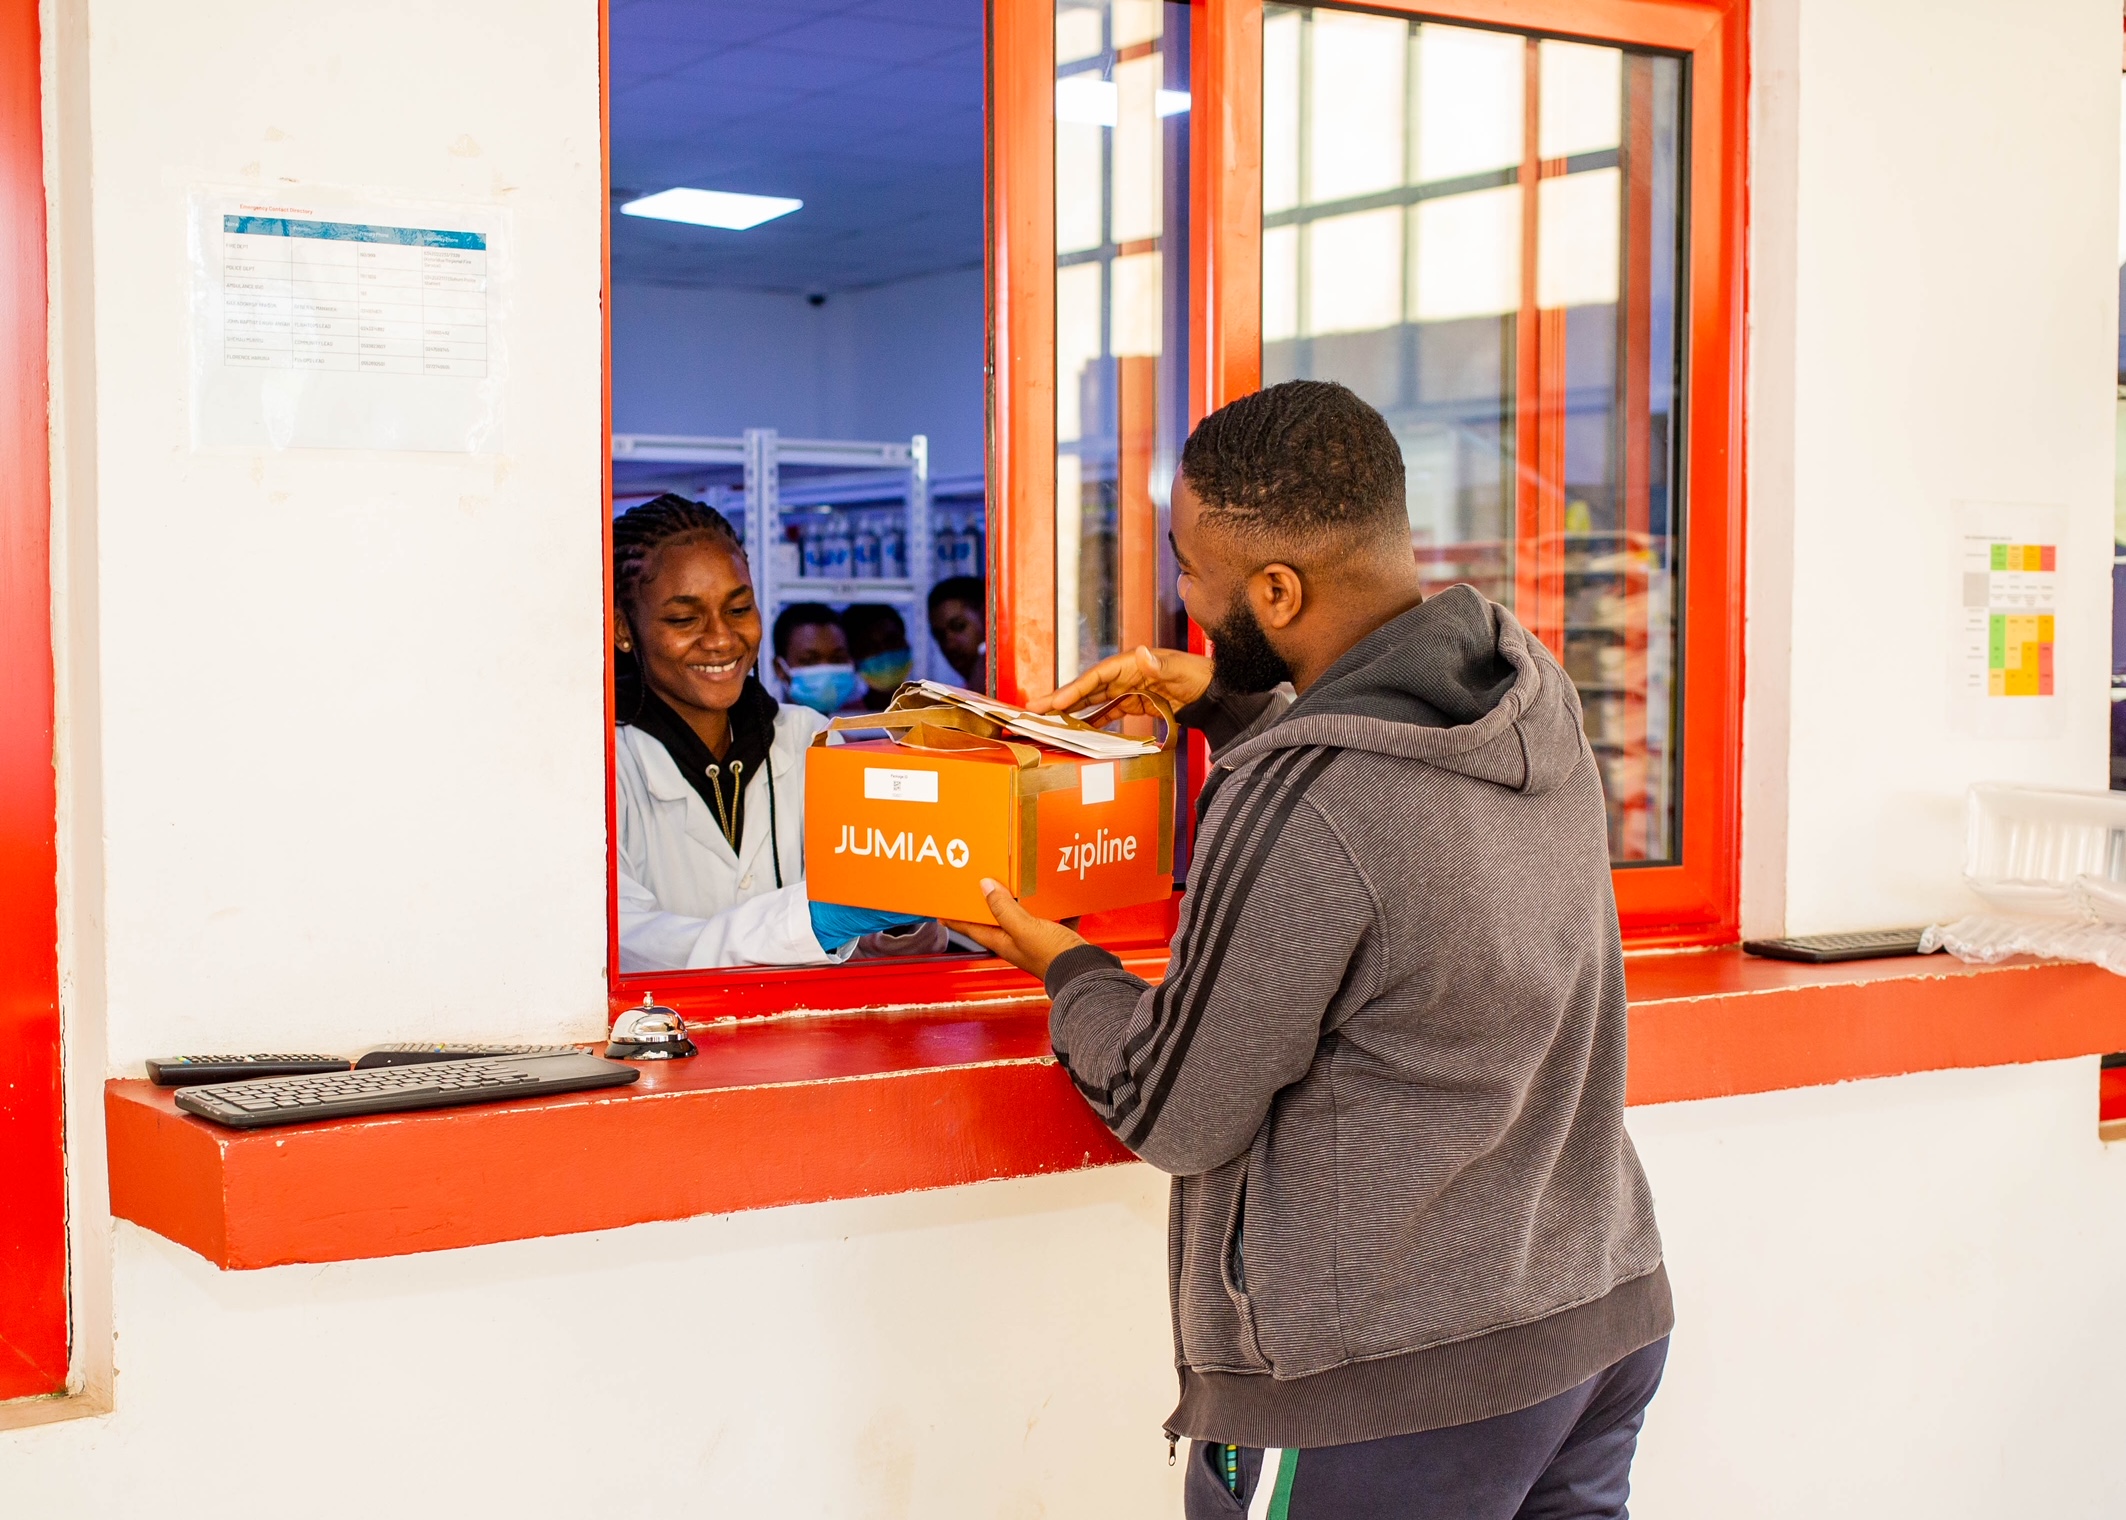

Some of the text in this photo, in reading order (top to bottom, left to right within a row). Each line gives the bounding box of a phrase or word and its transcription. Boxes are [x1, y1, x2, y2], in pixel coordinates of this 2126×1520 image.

[239, 203, 268, 212] Emergency
[290, 207, 313, 215] Directory
[834, 824, 944, 865] JUMIA
[1056, 828, 1137, 880] zipline
